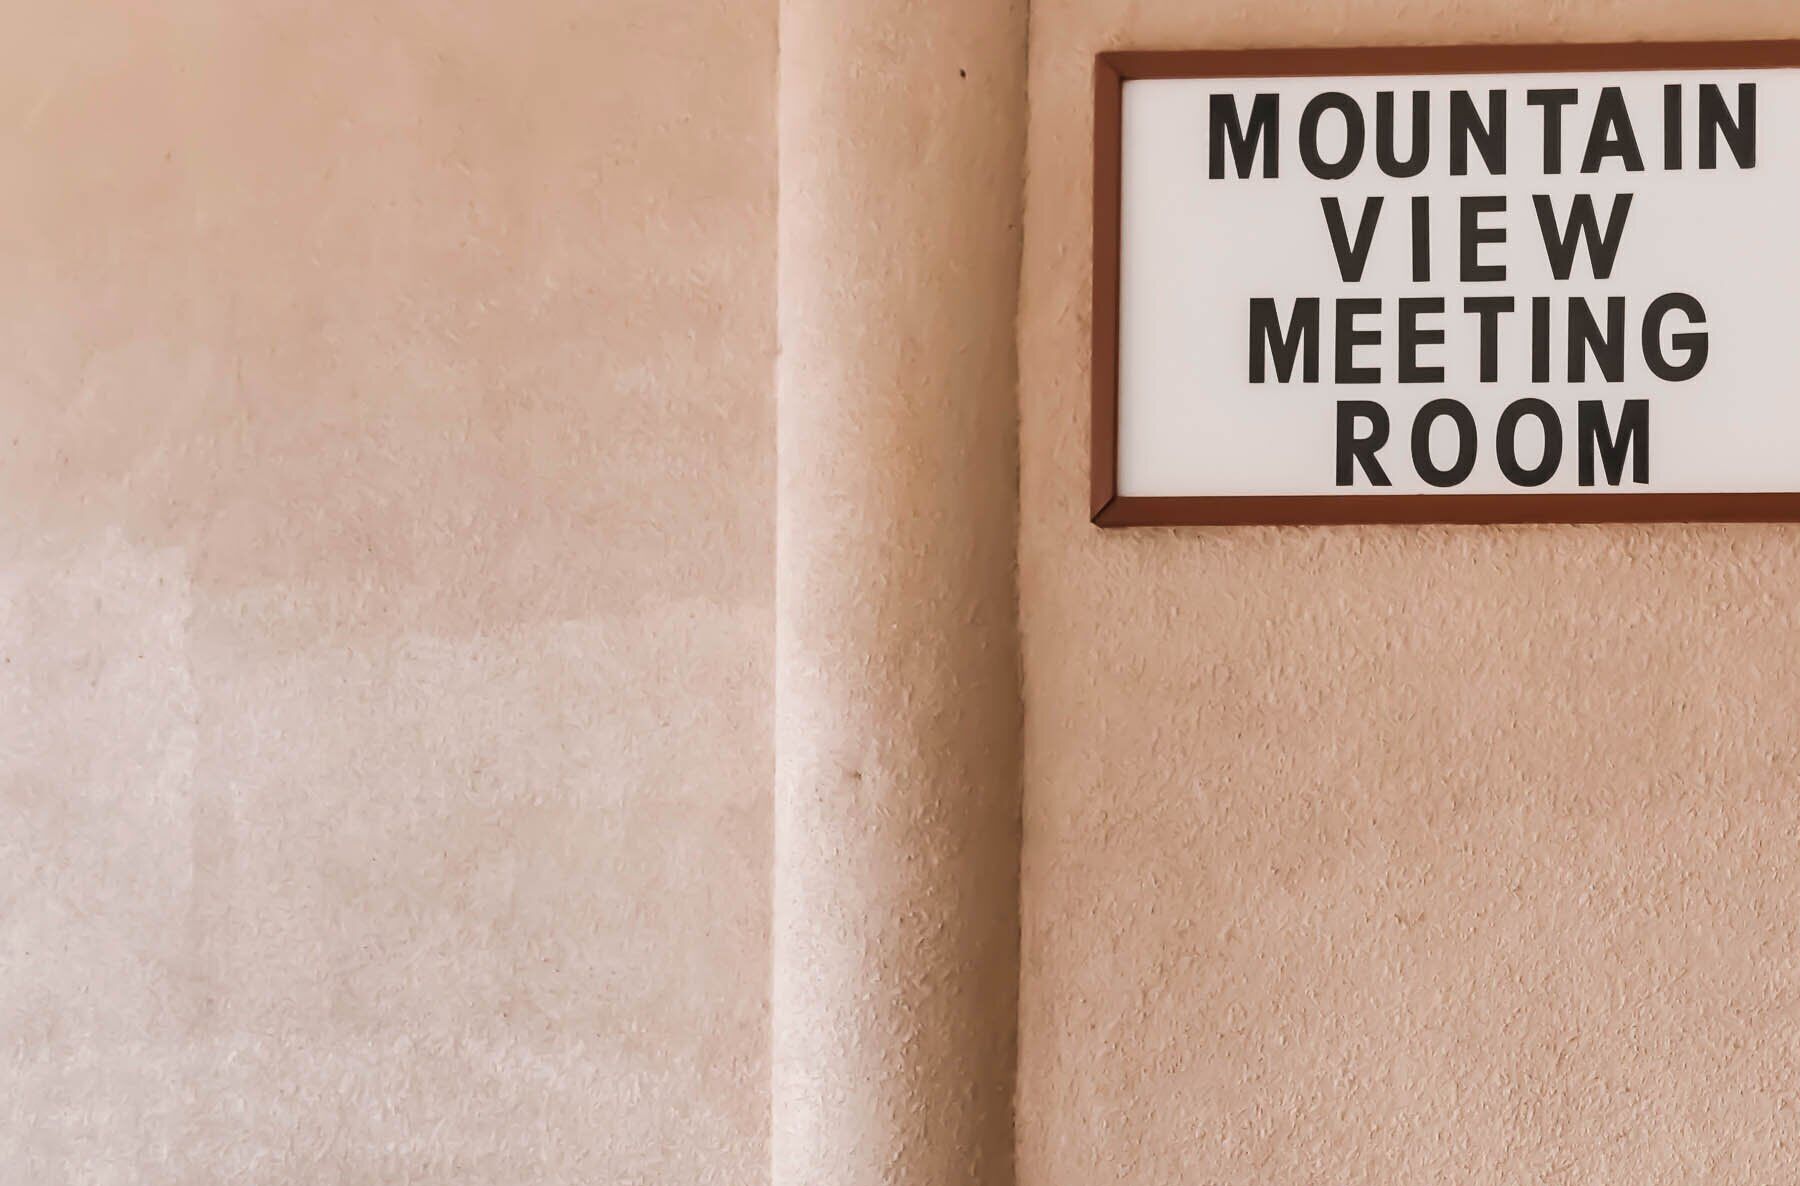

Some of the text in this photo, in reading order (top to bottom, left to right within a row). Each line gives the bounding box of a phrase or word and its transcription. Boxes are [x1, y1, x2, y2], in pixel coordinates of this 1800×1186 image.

[1207, 82, 1757, 181] MOUNTAIN
[1320, 192, 1634, 283] VIEW
[1248, 291, 1710, 385] MEETING
[1335, 397, 1650, 488] ROOM
